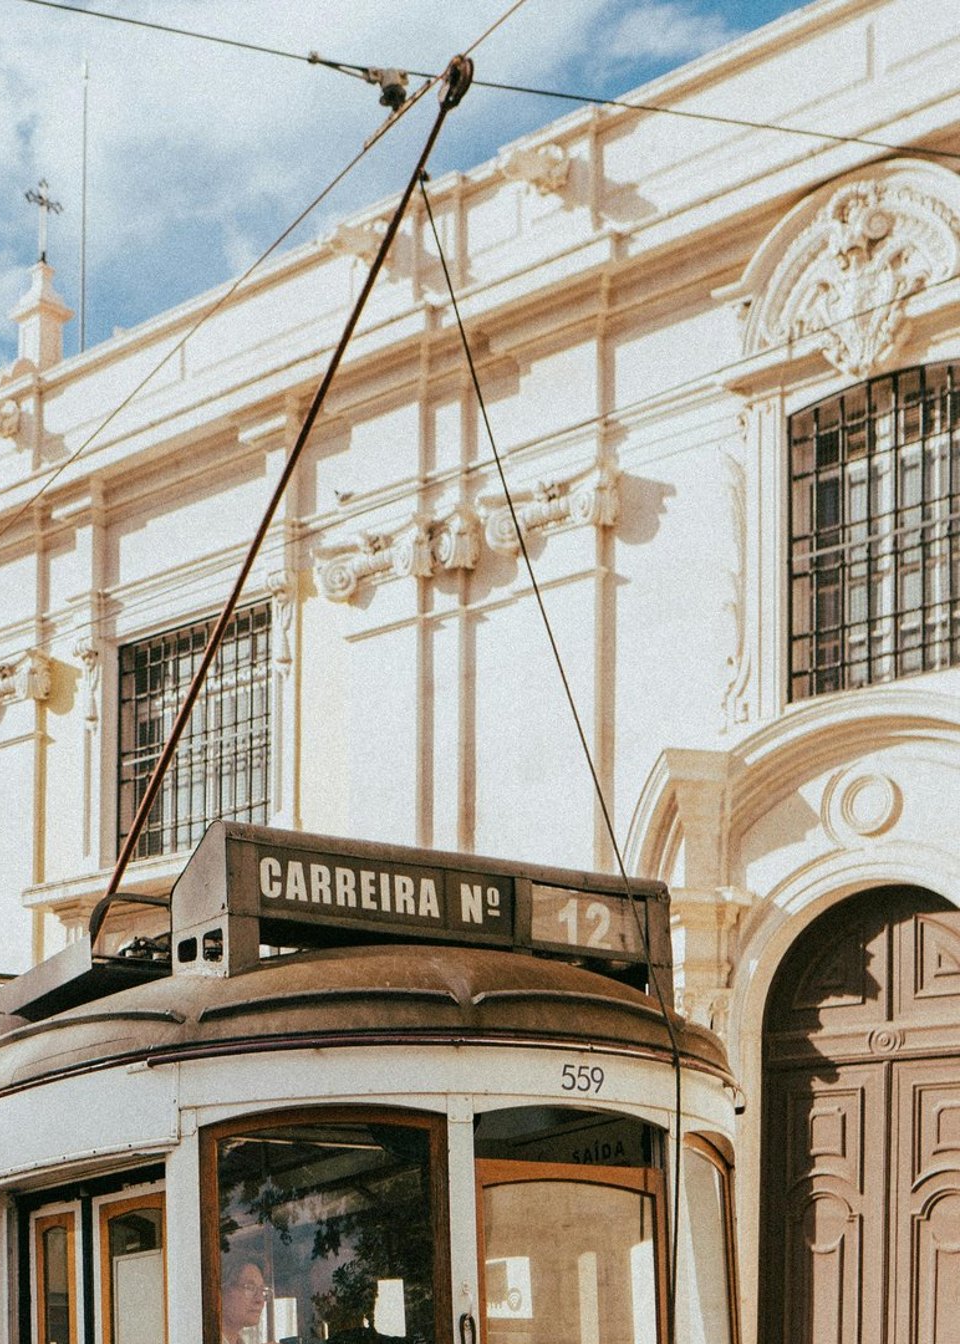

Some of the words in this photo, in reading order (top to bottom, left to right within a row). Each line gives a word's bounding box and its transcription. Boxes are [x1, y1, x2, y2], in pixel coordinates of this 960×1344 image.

[259, 856, 441, 918] CARREIRA
[558, 898, 612, 950] 12
[561, 1063, 605, 1094] 559
